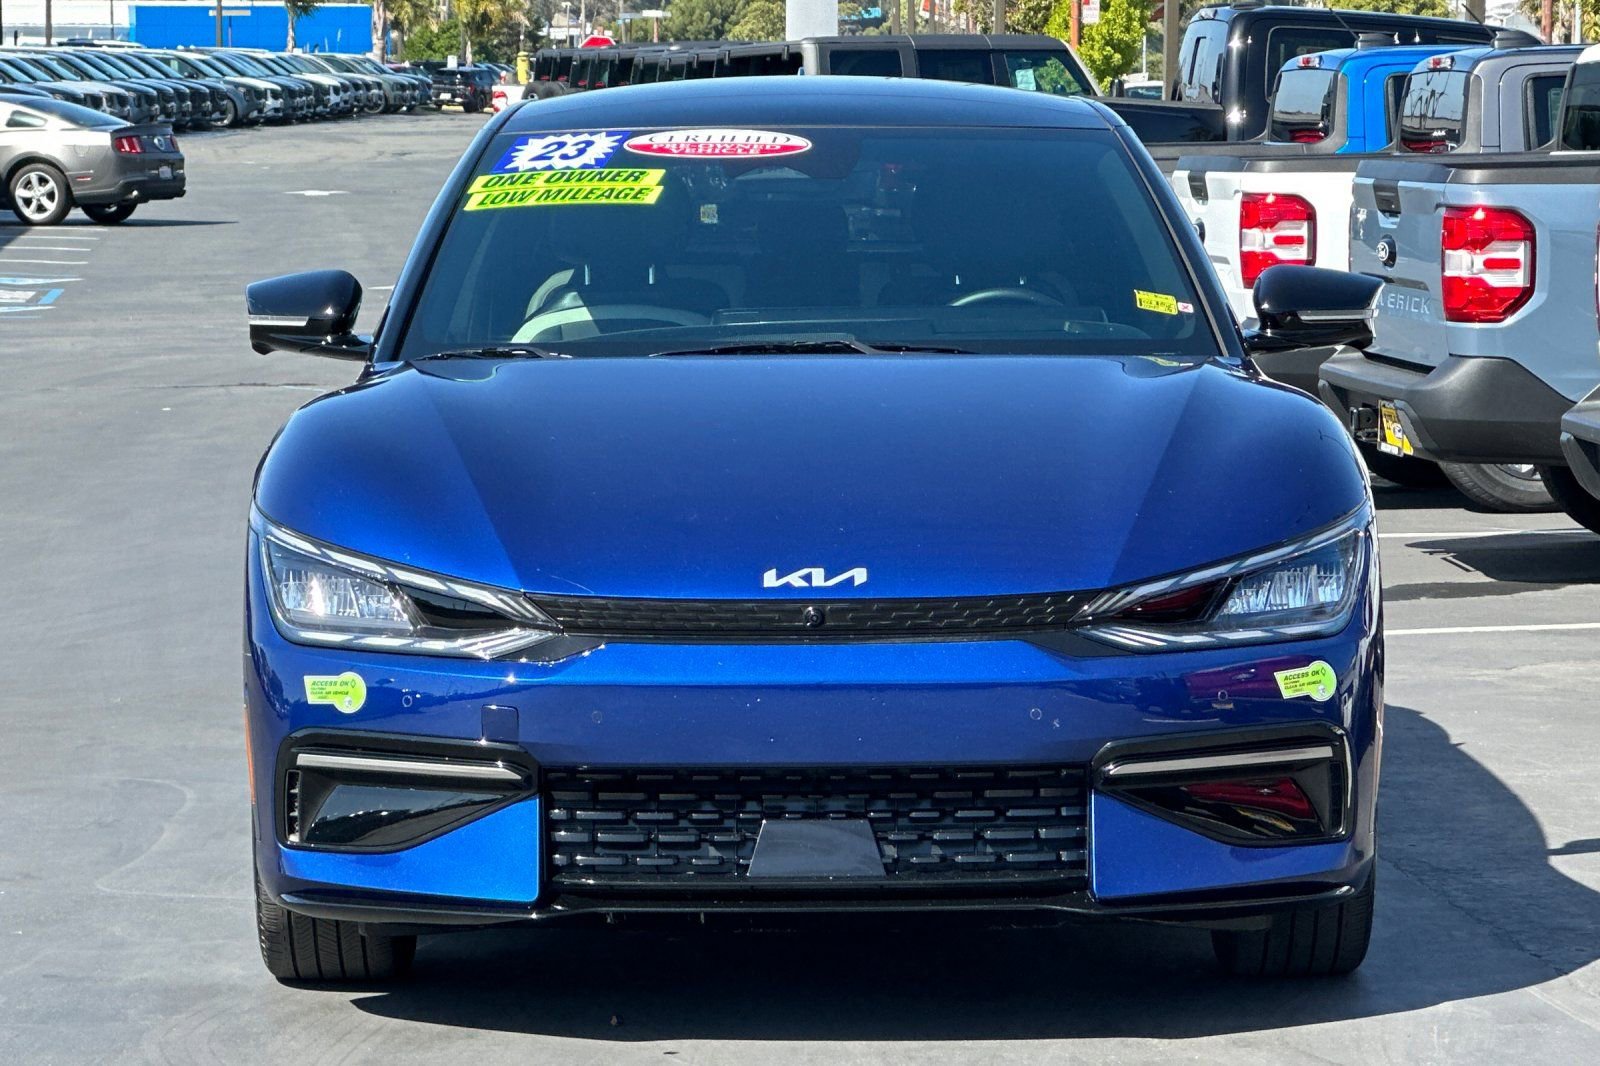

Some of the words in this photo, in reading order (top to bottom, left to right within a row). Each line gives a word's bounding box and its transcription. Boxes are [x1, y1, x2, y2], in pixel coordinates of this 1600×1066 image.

[528, 139, 596, 162] 23
[669, 147, 762, 156] VEHICLE
[481, 173, 542, 189] ONE
[543, 169, 649, 185] OWNER
[476, 189, 541, 206] LOW
[535, 185, 655, 202] MILEAGE
[763, 567, 867, 587] KIA
[1283, 672, 1309, 681] ACCESS
